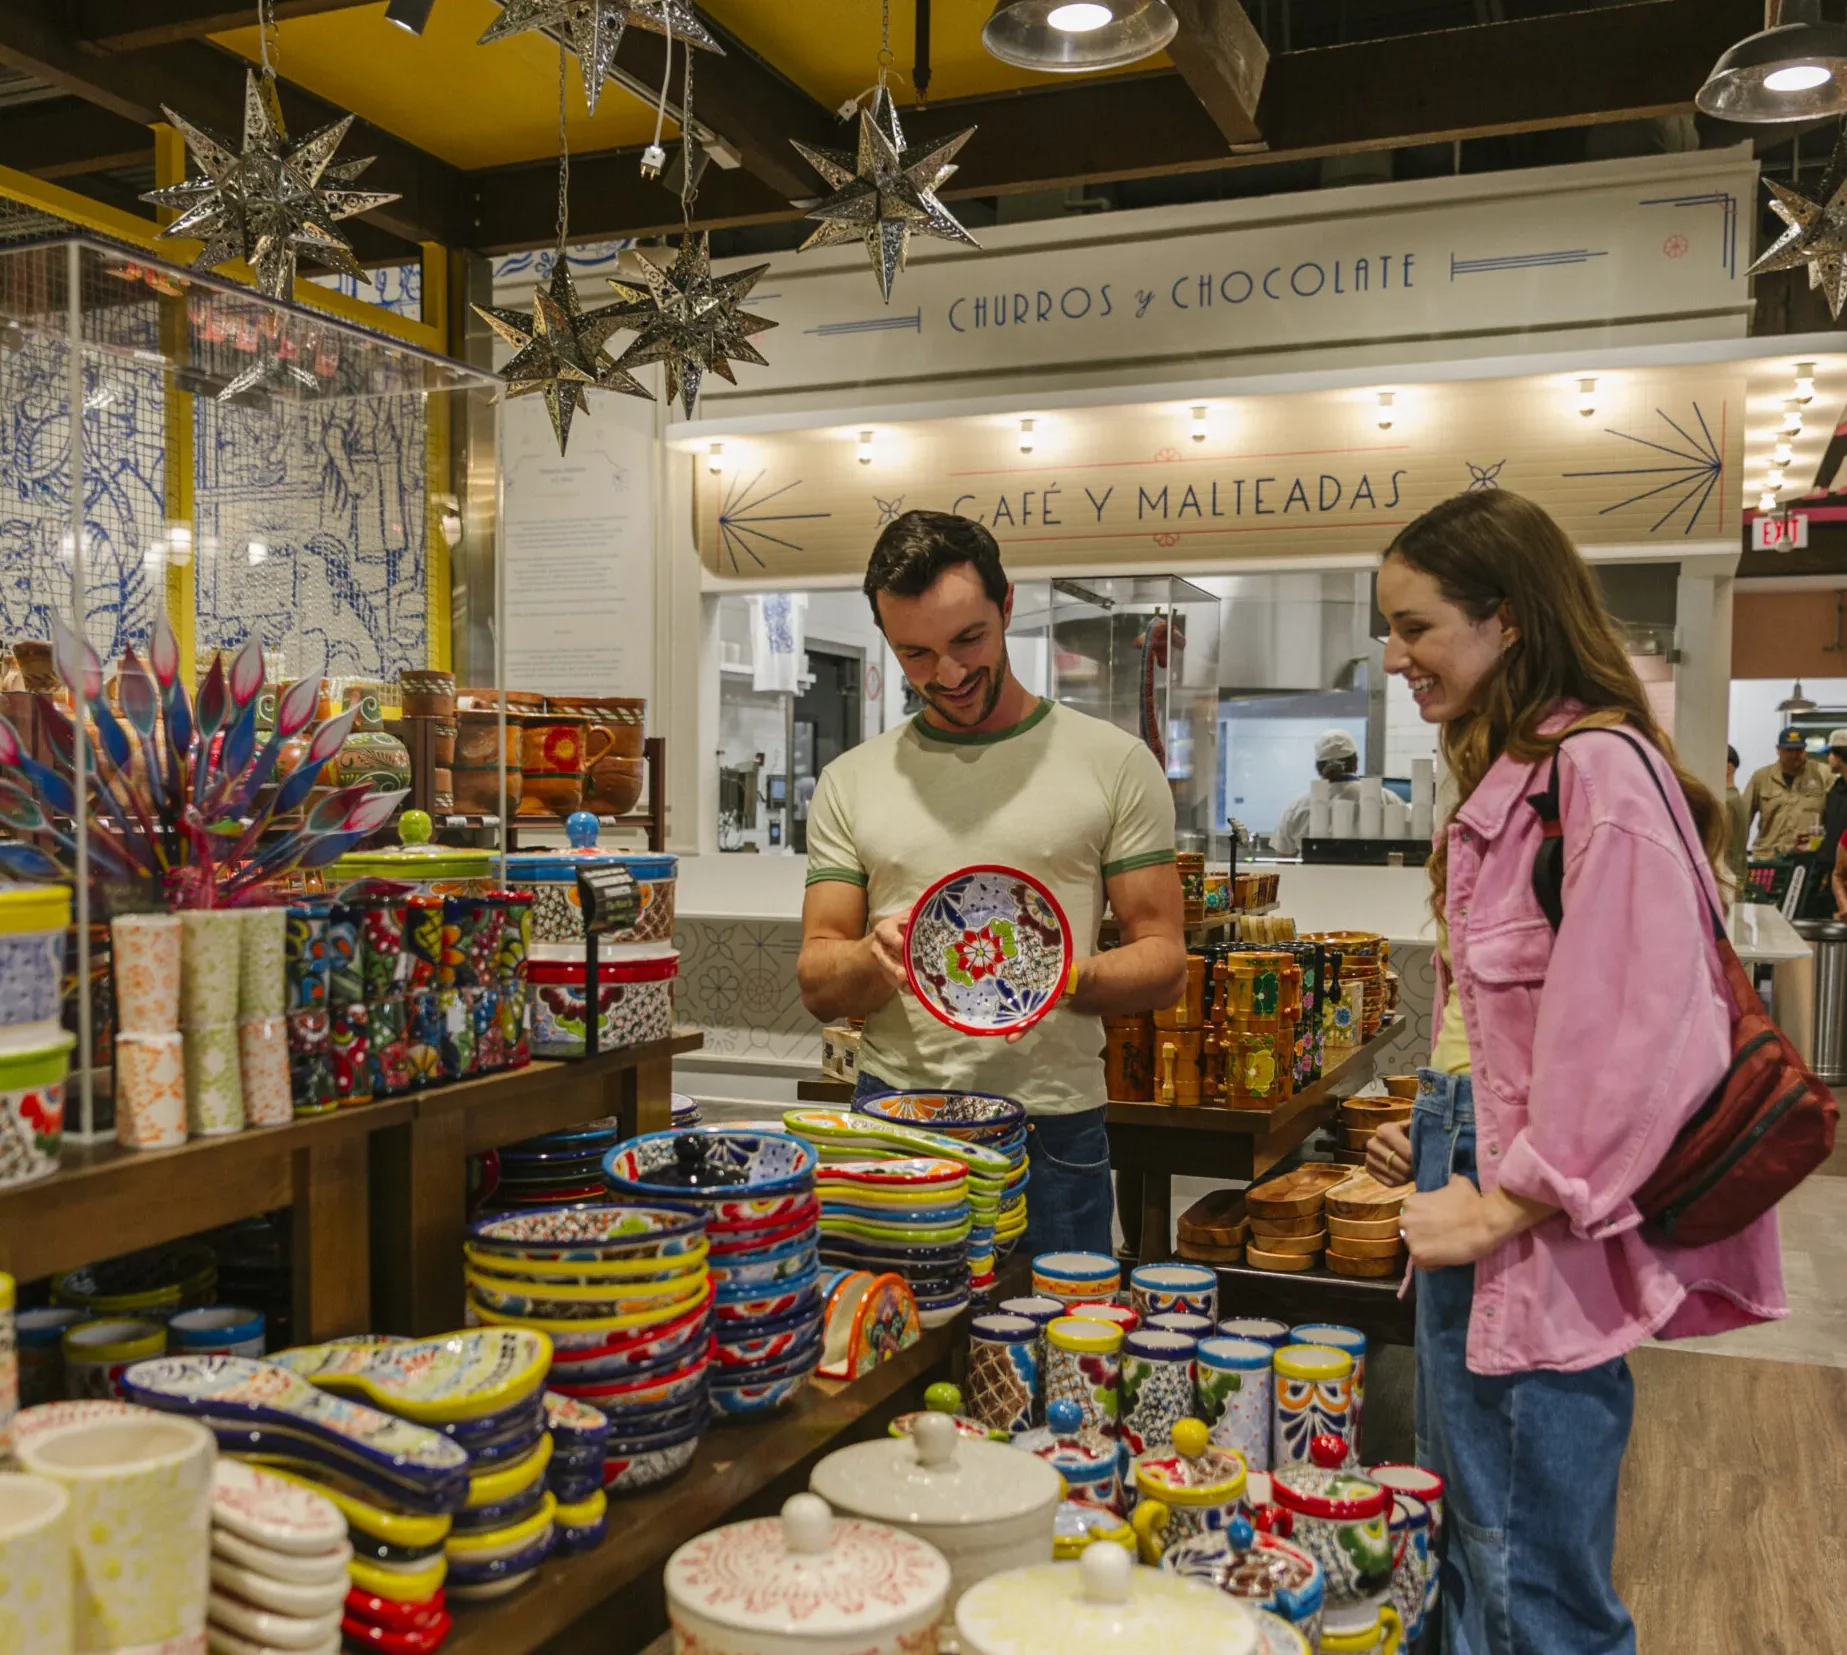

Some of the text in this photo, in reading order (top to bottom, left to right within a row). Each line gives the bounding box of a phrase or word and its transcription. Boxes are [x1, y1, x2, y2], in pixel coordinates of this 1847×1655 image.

[949, 254, 1416, 333] CHURROS y CHOCOLATE
[953, 470, 1408, 527] CAFÉ Y MALTEADAS
